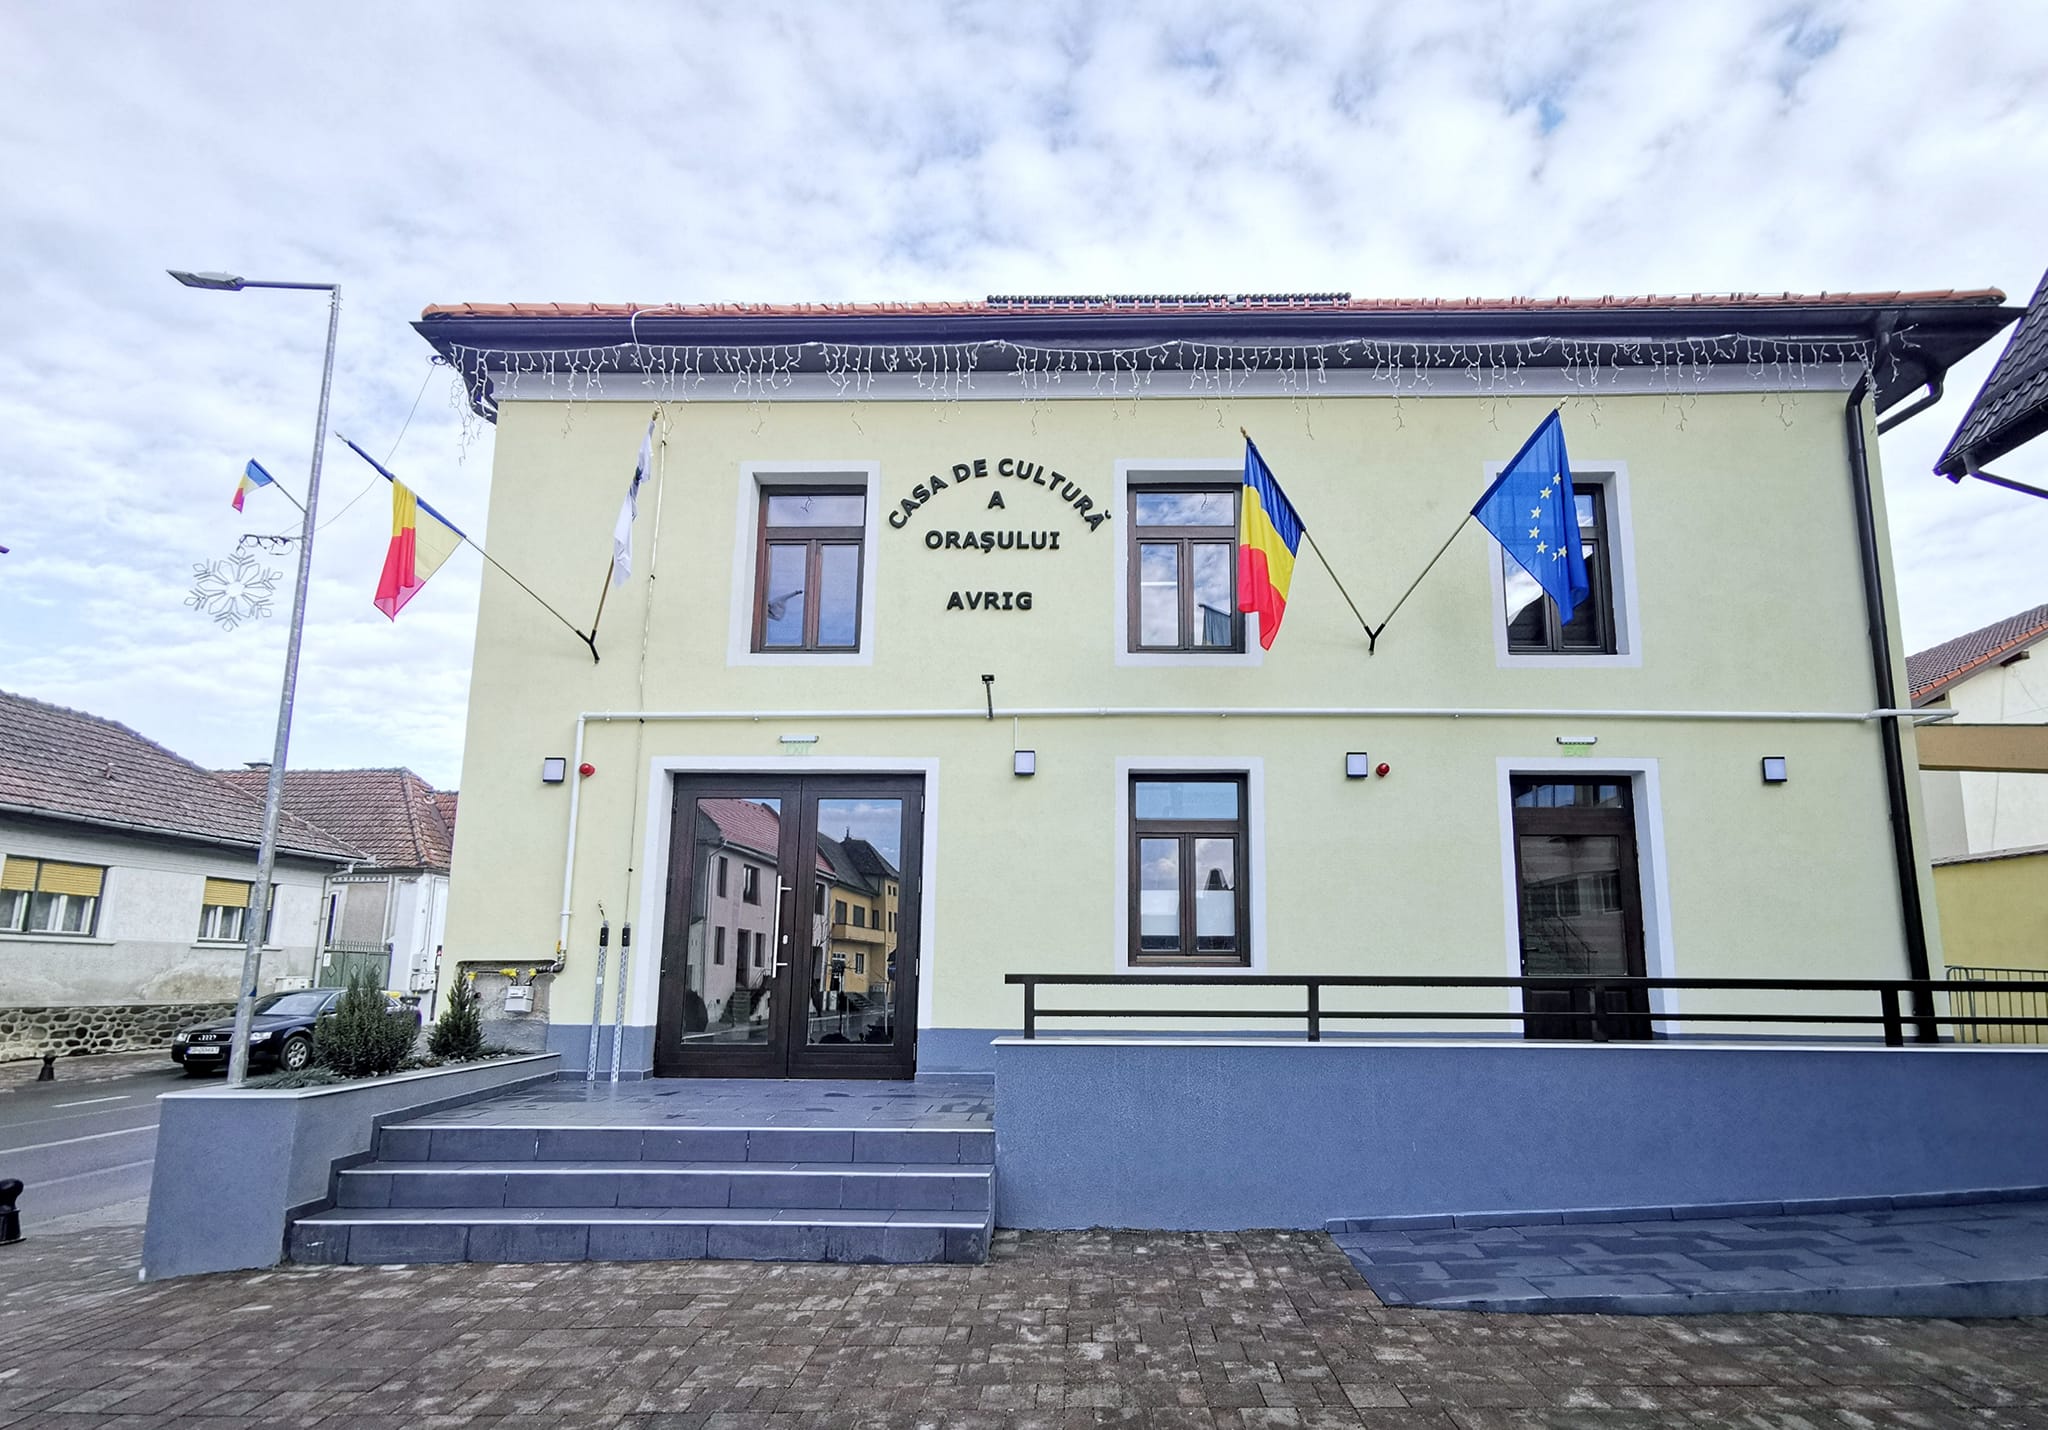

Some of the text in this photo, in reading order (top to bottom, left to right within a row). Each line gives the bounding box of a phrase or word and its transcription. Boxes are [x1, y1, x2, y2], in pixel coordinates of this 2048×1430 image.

[888, 458, 1112, 533] CASA DE CULTURĂ
[987, 490, 1006, 510] A
[946, 591, 1033, 611] AVRIG
